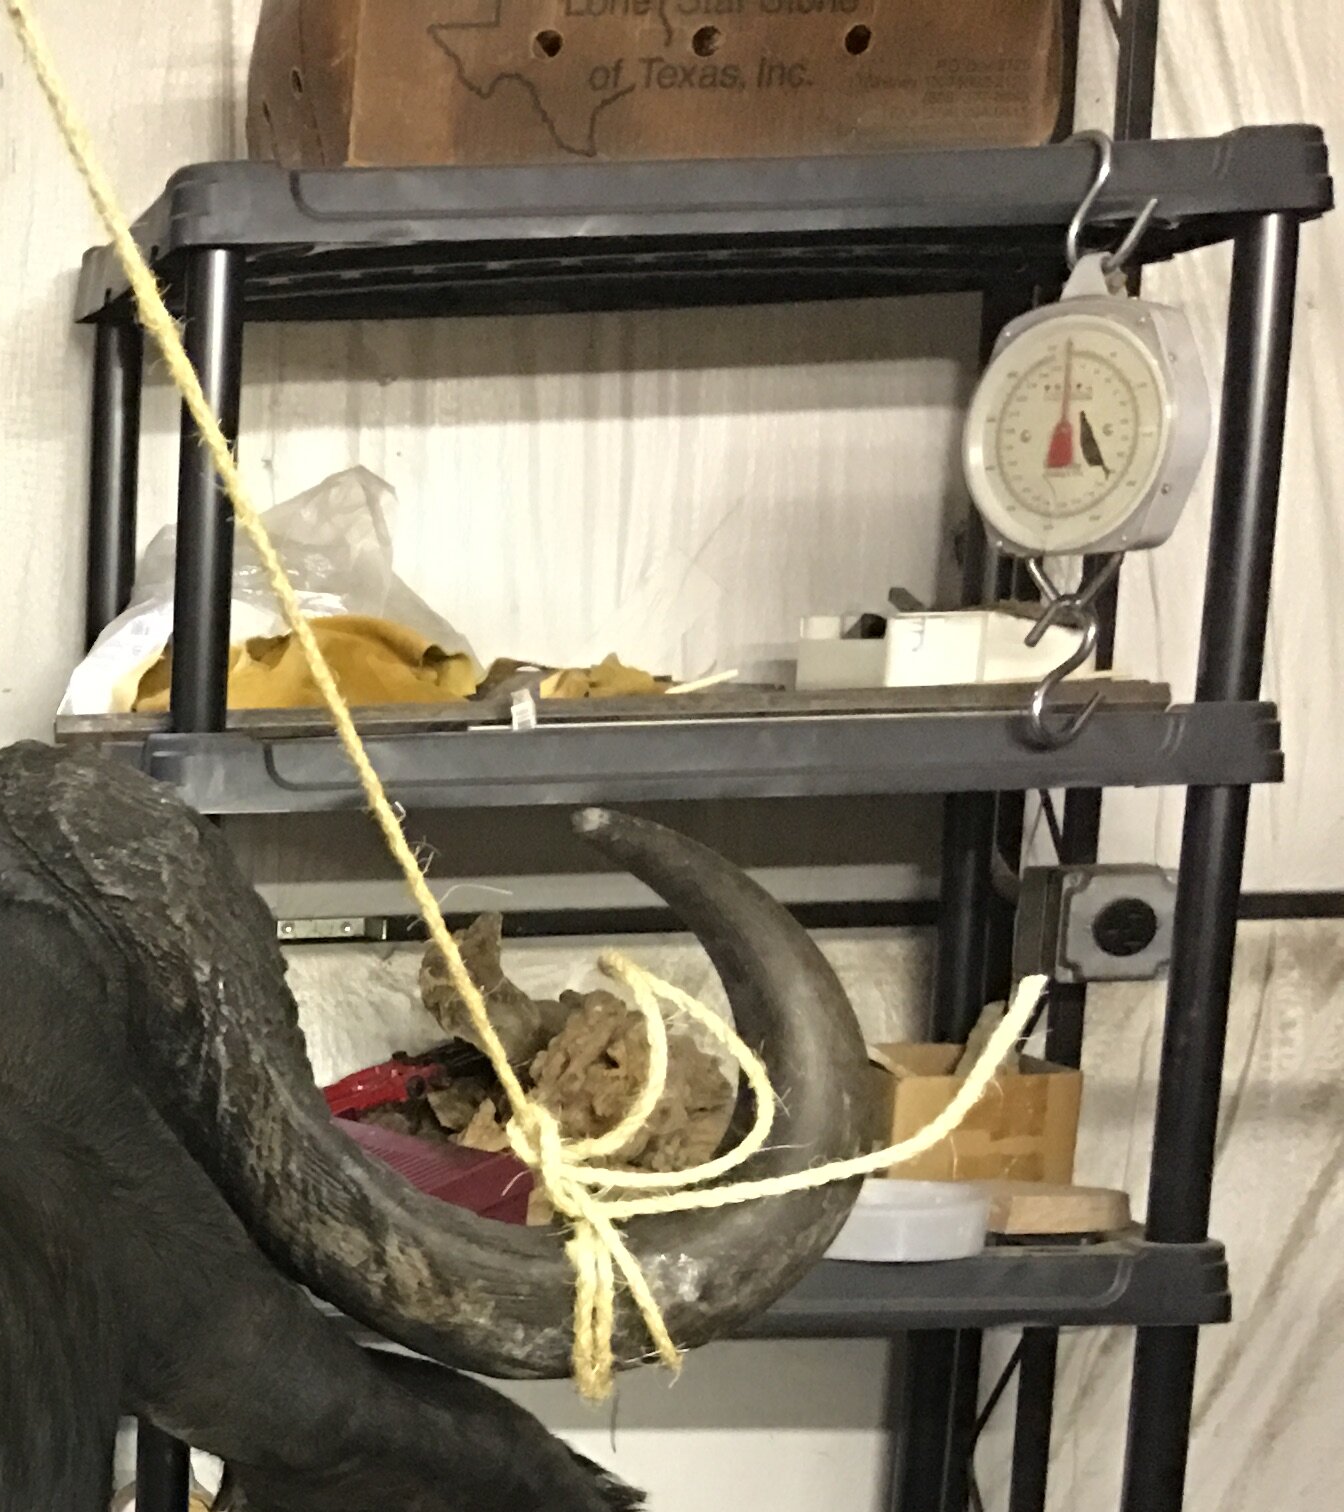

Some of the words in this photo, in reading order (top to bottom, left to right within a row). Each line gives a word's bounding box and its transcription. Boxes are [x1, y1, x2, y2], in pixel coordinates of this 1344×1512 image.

[588, 57, 623, 91] of
[639, 56, 746, 91] Texas,
[756, 57, 815, 89] Inc.
